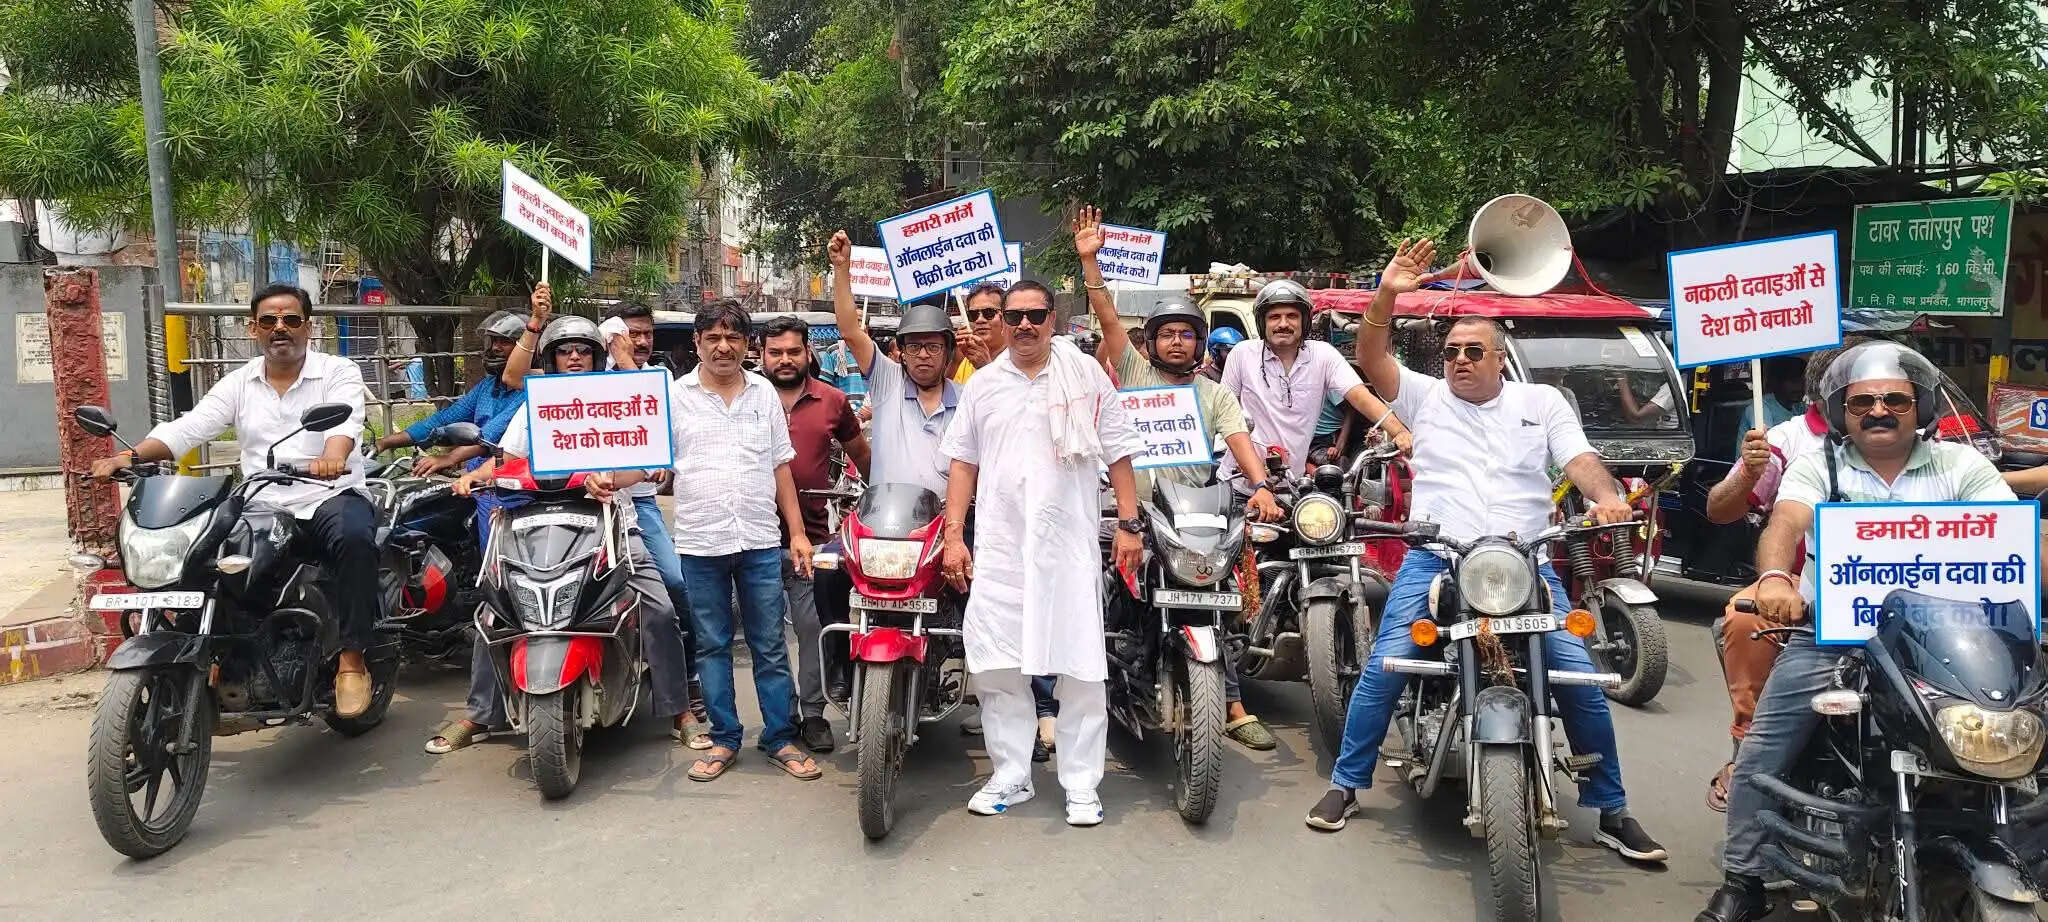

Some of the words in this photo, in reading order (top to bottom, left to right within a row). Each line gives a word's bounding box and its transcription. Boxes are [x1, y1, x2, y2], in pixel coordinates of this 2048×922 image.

[512, 181, 541, 208] नकली
[536, 215, 549, 232] को
[901, 213, 942, 238] हमारी
[1868, 219, 1901, 242] टावर
[1908, 216, 1963, 250] ततारपुर
[1971, 215, 1995, 239] पथ
[895, 237, 954, 268] ऑनलाईन
[954, 231, 977, 249] दवा
[975, 222, 995, 241] की
[1130, 250, 1145, 262] दवा
[1146, 251, 1159, 264] की
[913, 264, 944, 288] बिक्री
[944, 259, 963, 278] बंद
[1859, 265, 1874, 276] पथ
[1878, 260, 1891, 276] की
[1935, 262, 1960, 276] 1.60
[1684, 274, 1738, 304] नकली
[1808, 263, 1826, 288] से
[1701, 313, 1730, 337] देश
[1733, 308, 1757, 333] को
[1760, 300, 1813, 329] बचाओ
[537, 398, 584, 421] नकली
[643, 395, 658, 416] से
[1152, 419, 1176, 432] दवा
[1178, 414, 1196, 431] की
[552, 430, 578, 450] देश
[579, 427, 600, 448] को
[602, 425, 648, 448] बचाओ
[1855, 514, 1932, 540] हमारी
[1829, 554, 1942, 588] ऑनलाईन
[1945, 561, 1988, 585] दवा
[1992, 554, 2026, 585] की
[1167, 592, 1180, 602] JH
[1213, 594, 1238, 605] 7371
